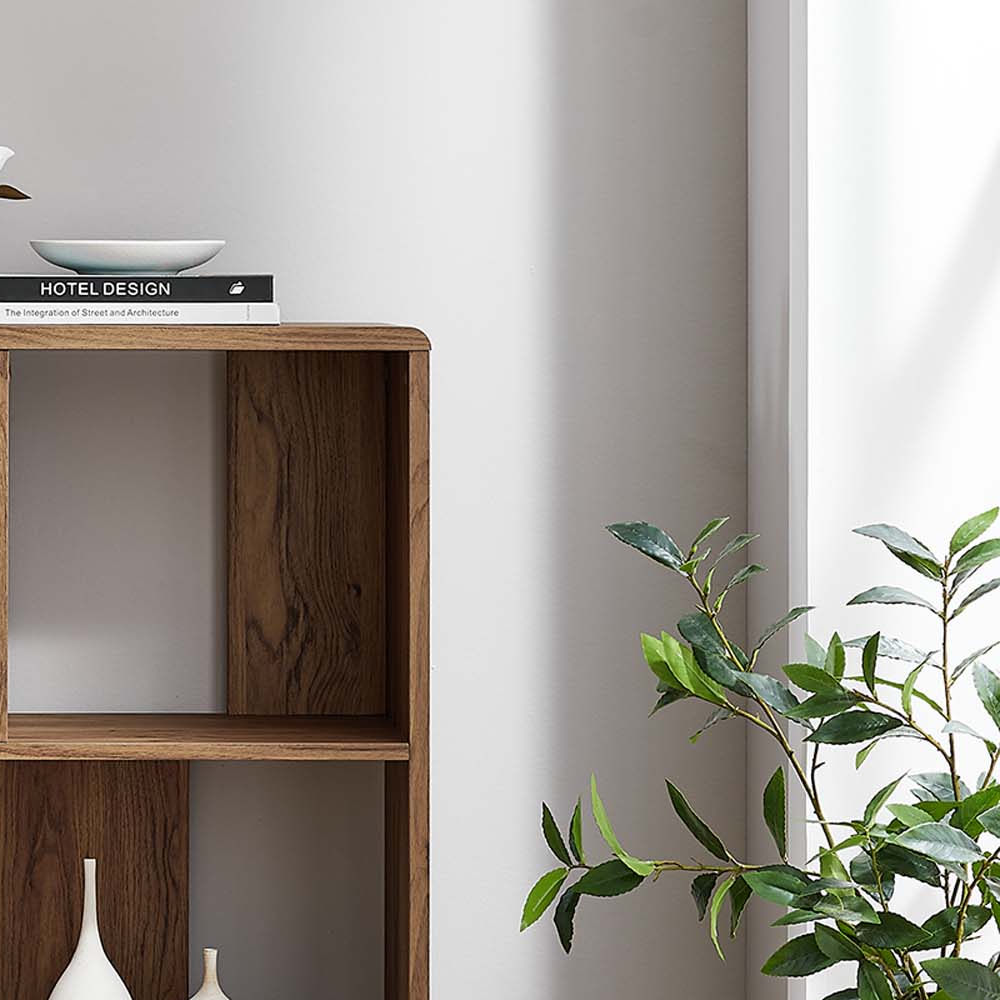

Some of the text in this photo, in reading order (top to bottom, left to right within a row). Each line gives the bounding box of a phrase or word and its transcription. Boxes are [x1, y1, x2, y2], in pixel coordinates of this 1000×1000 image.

[40, 282, 171, 296] HOTEL DESIGN
[4, 307, 180, 319] The Integration of Street and Architecture
